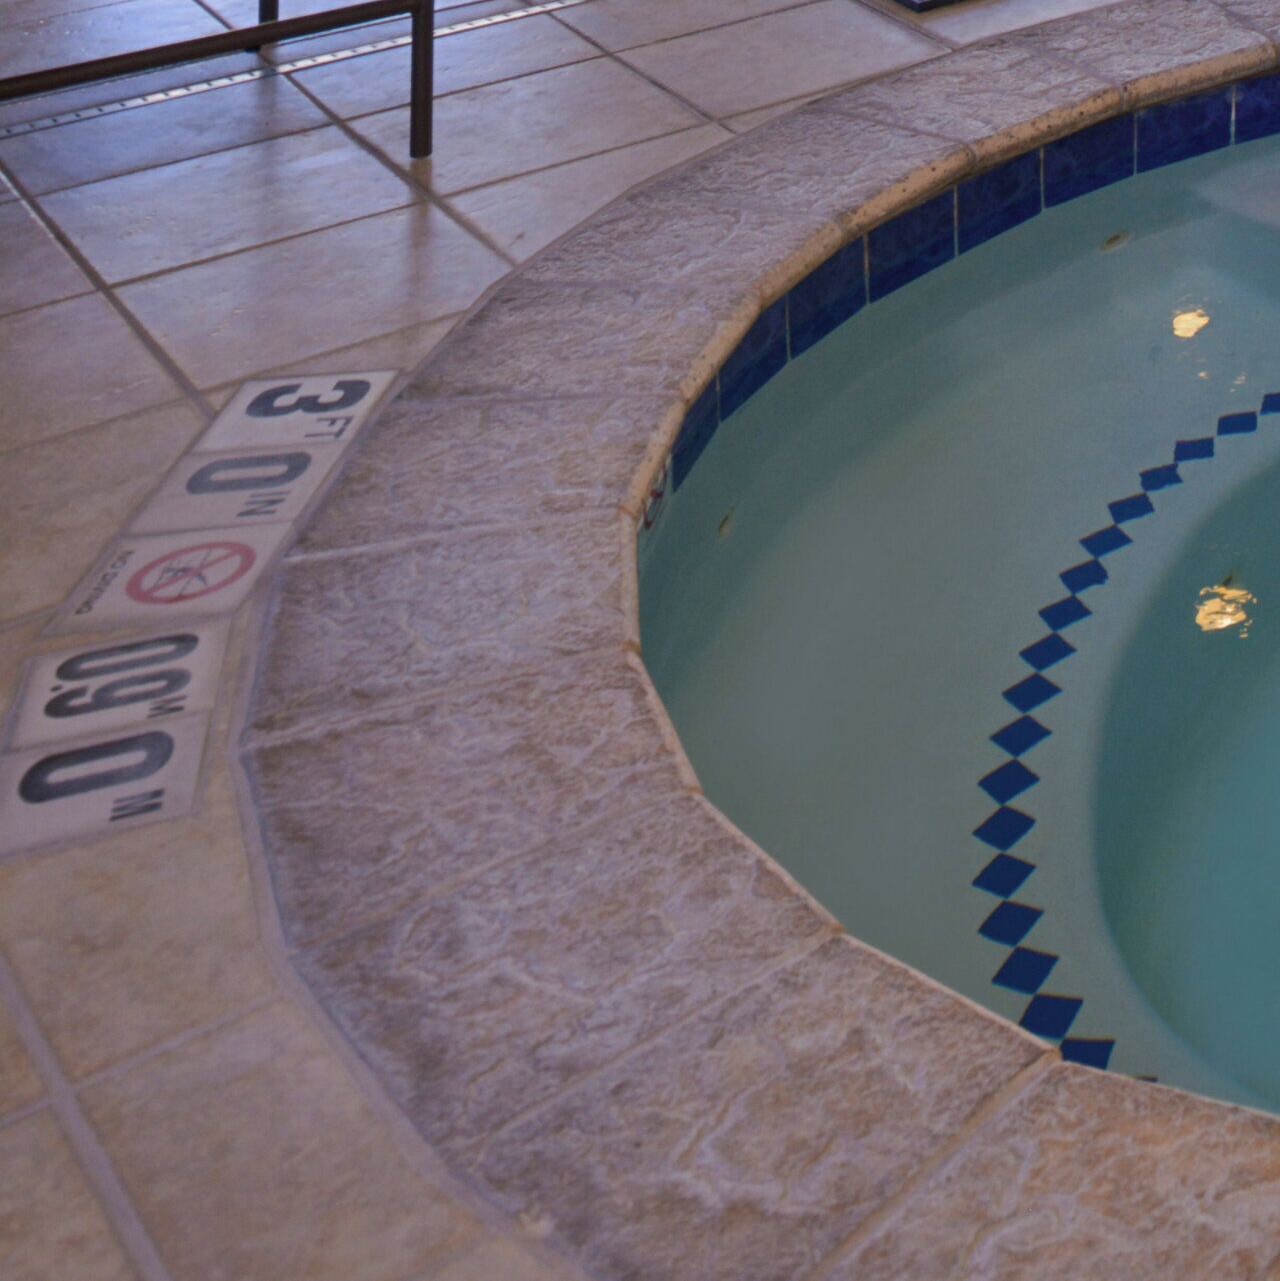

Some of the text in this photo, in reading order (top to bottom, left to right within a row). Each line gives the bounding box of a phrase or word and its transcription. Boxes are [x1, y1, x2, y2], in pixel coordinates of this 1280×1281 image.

[186, 379, 371, 518] 3 FT 0 IN
